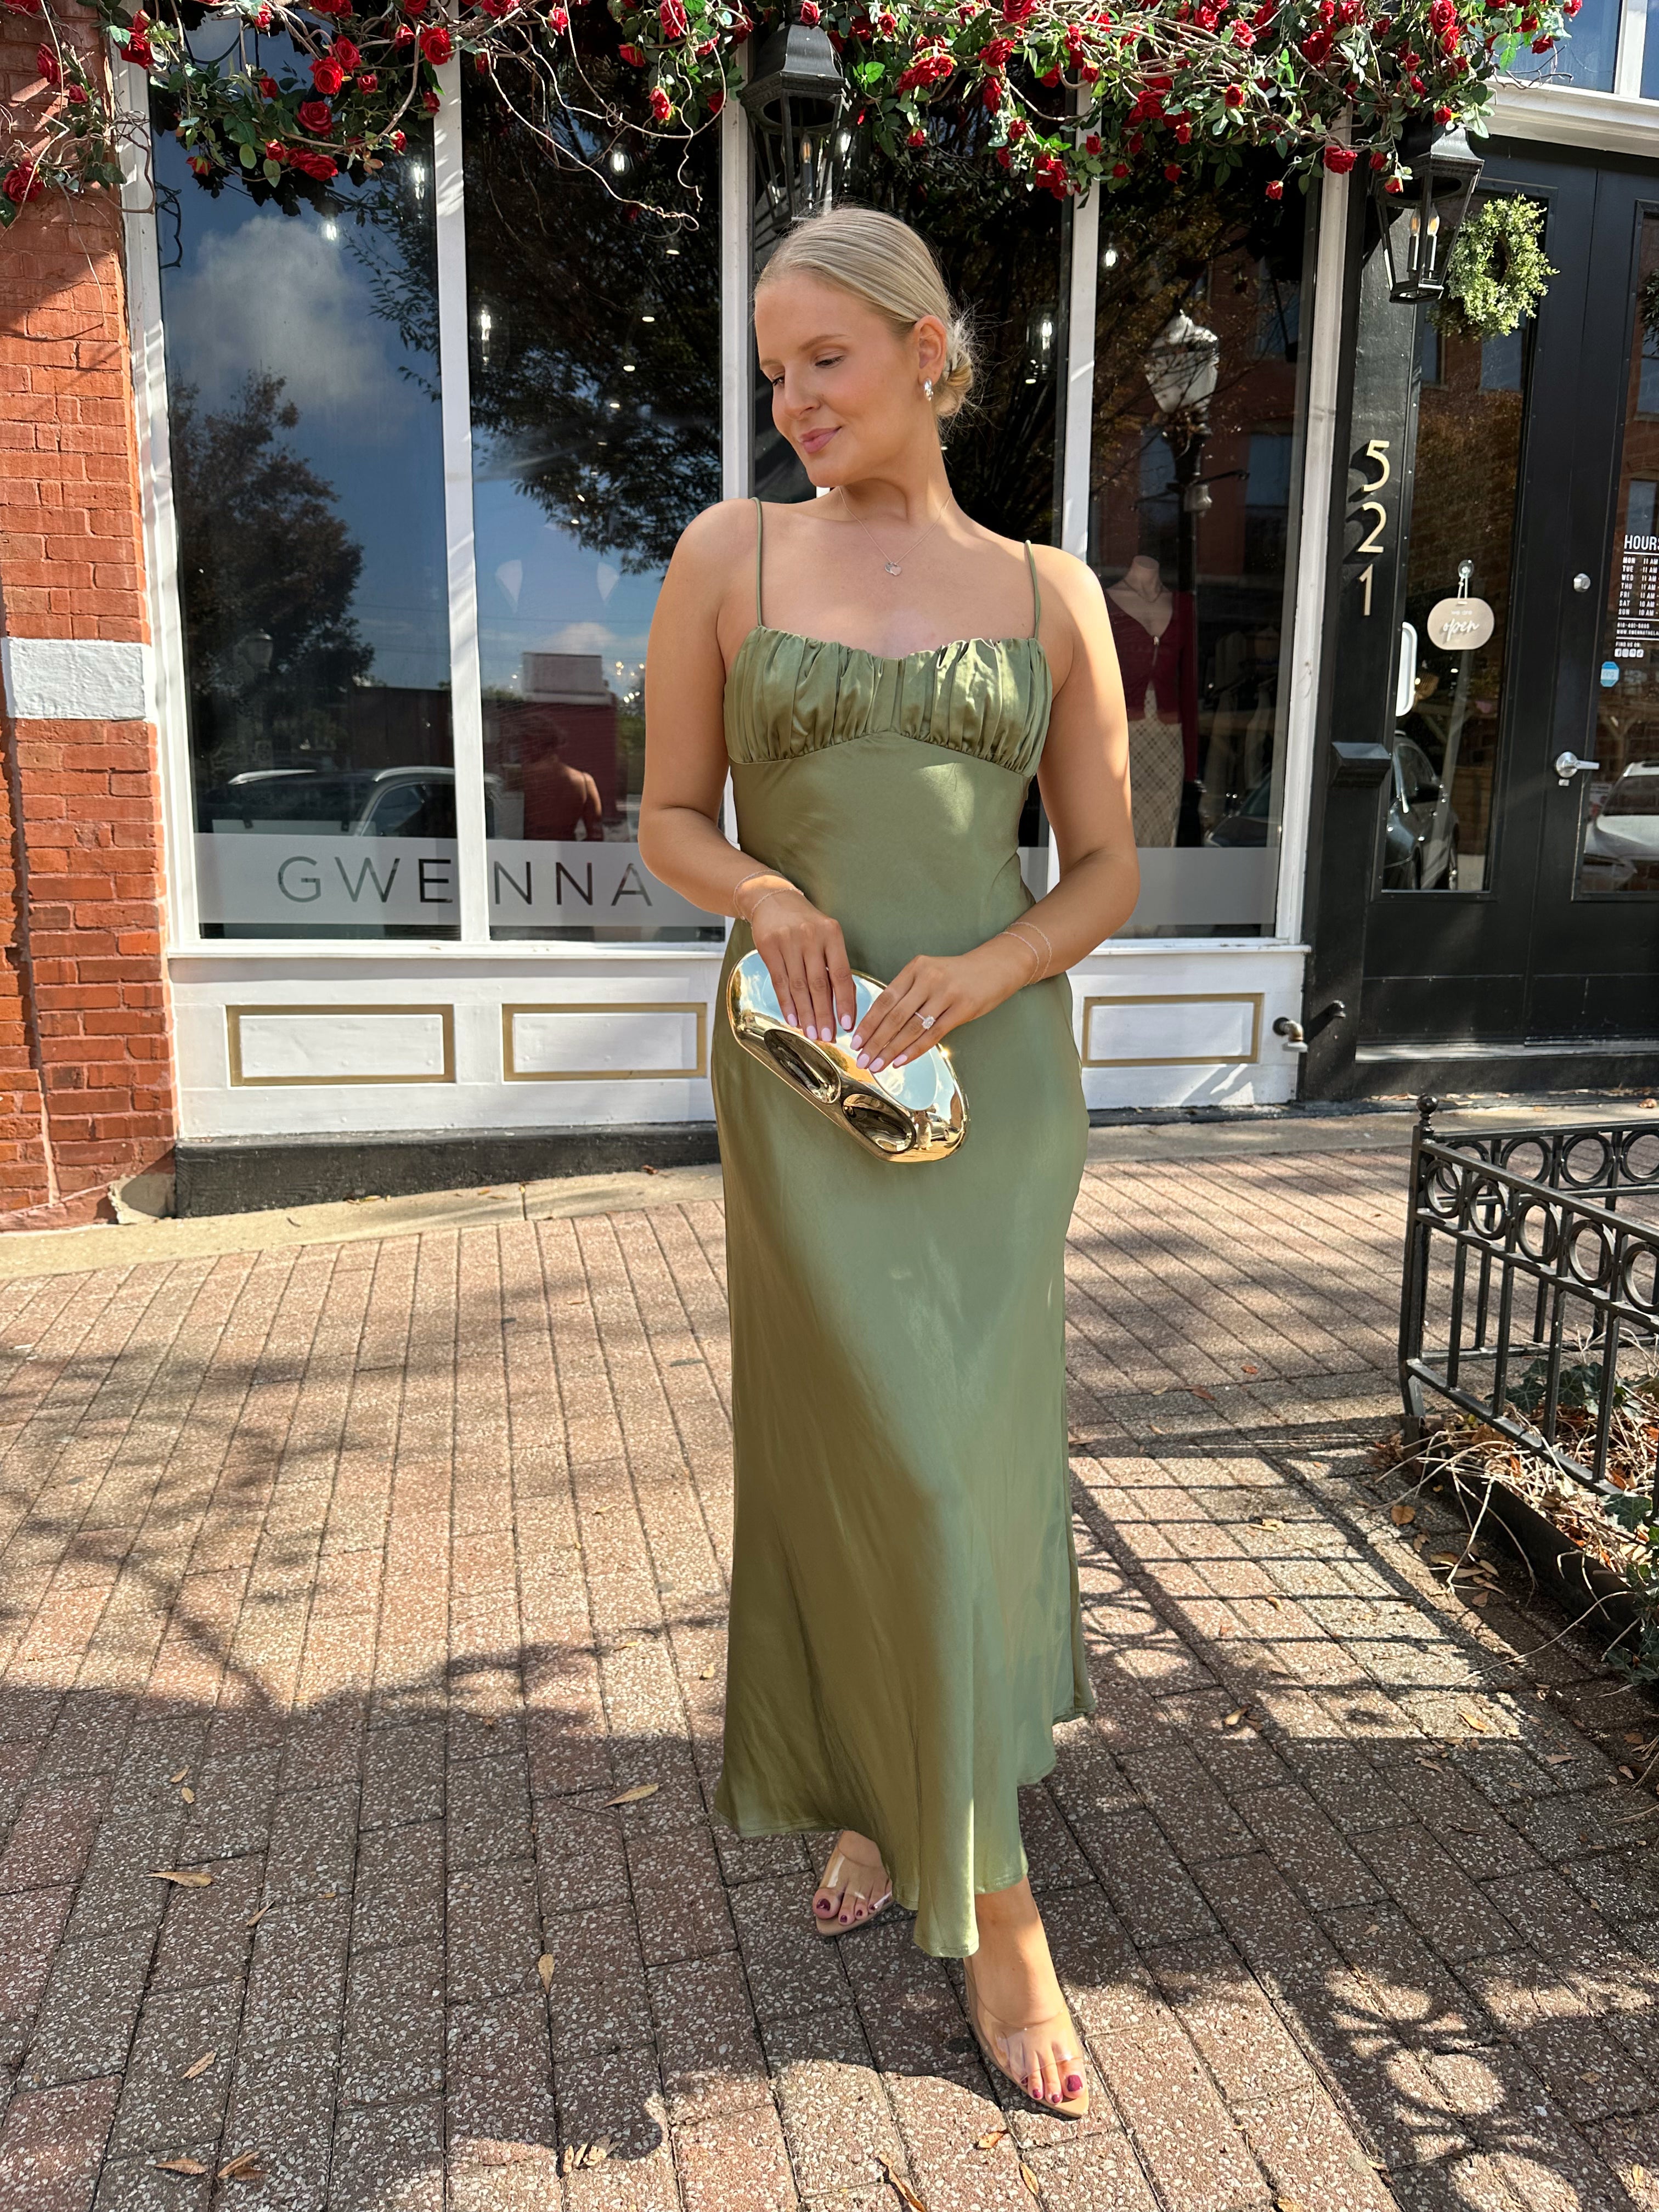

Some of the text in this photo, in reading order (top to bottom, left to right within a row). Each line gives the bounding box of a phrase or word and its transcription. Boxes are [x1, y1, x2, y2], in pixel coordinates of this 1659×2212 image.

[1357, 439, 1390, 616] 521
[1624, 534, 1659, 551] HOUR
[1442, 618, 1480, 642] open
[278, 856, 653, 907] GWENNA
